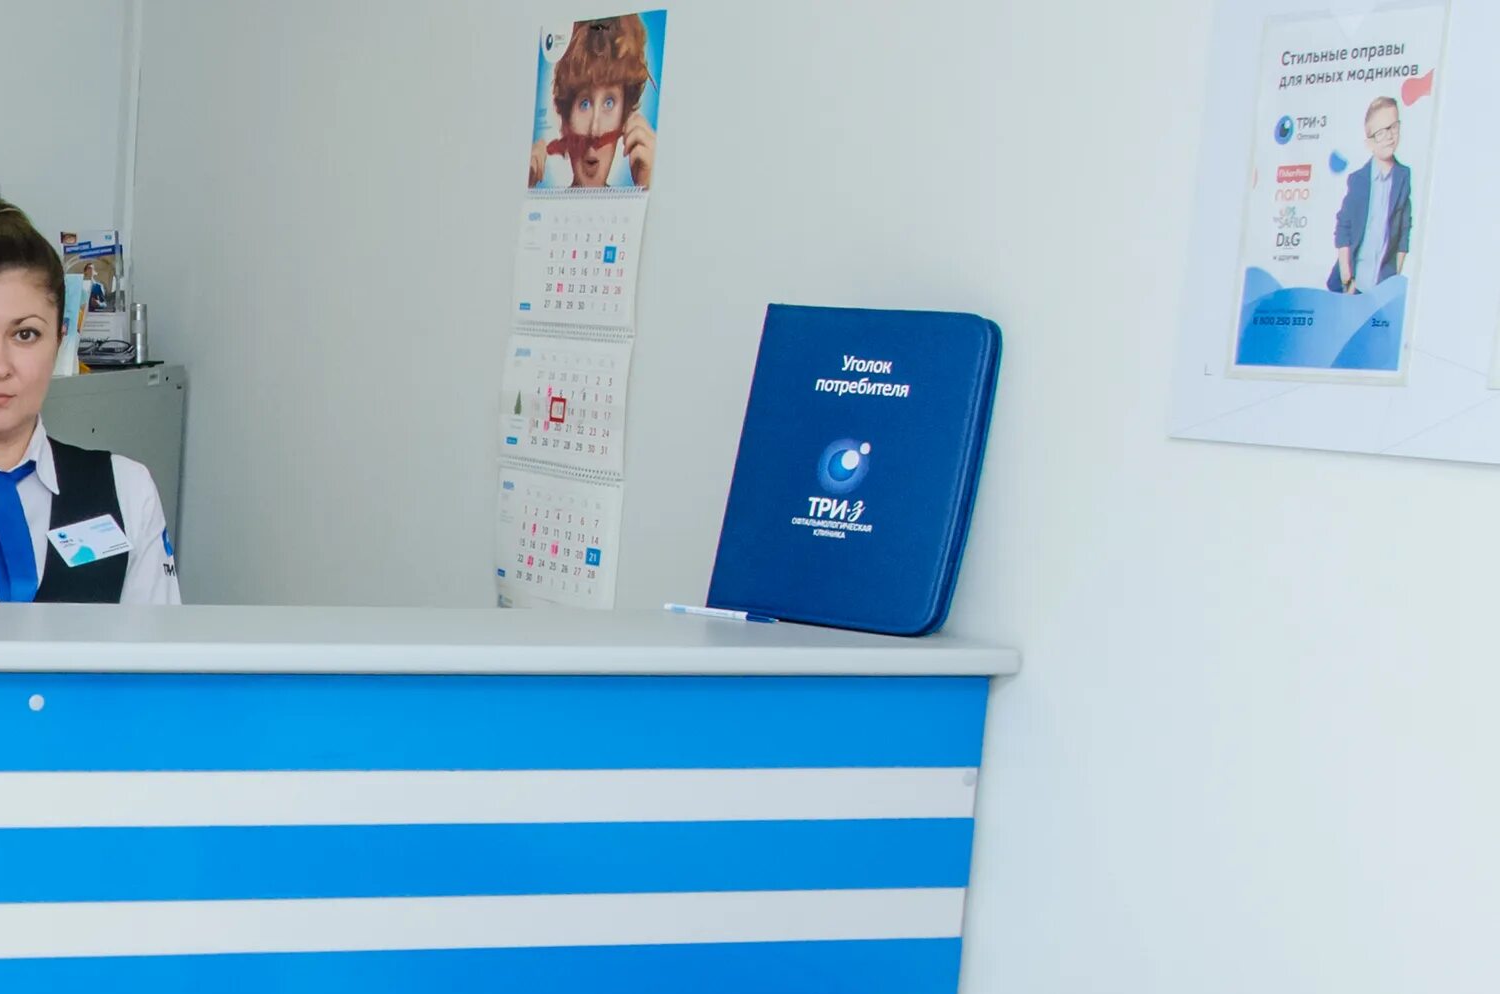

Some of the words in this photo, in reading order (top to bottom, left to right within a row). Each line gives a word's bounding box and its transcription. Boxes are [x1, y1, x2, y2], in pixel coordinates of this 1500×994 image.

[1281, 49, 1348, 66] Стильные
[1351, 43, 1405, 62] оправы
[1278, 75, 1303, 89] для
[1305, 70, 1344, 85] юных
[1347, 64, 1419, 82] модников
[1276, 232, 1301, 247] D&G
[841, 354, 893, 374] Уголок
[815, 377, 910, 398] потребителя
[791, 517, 873, 533] ОФТАЛЬМОЛОГИЧЕСКАЯ
[812, 528, 846, 539] КЛИНИКА
